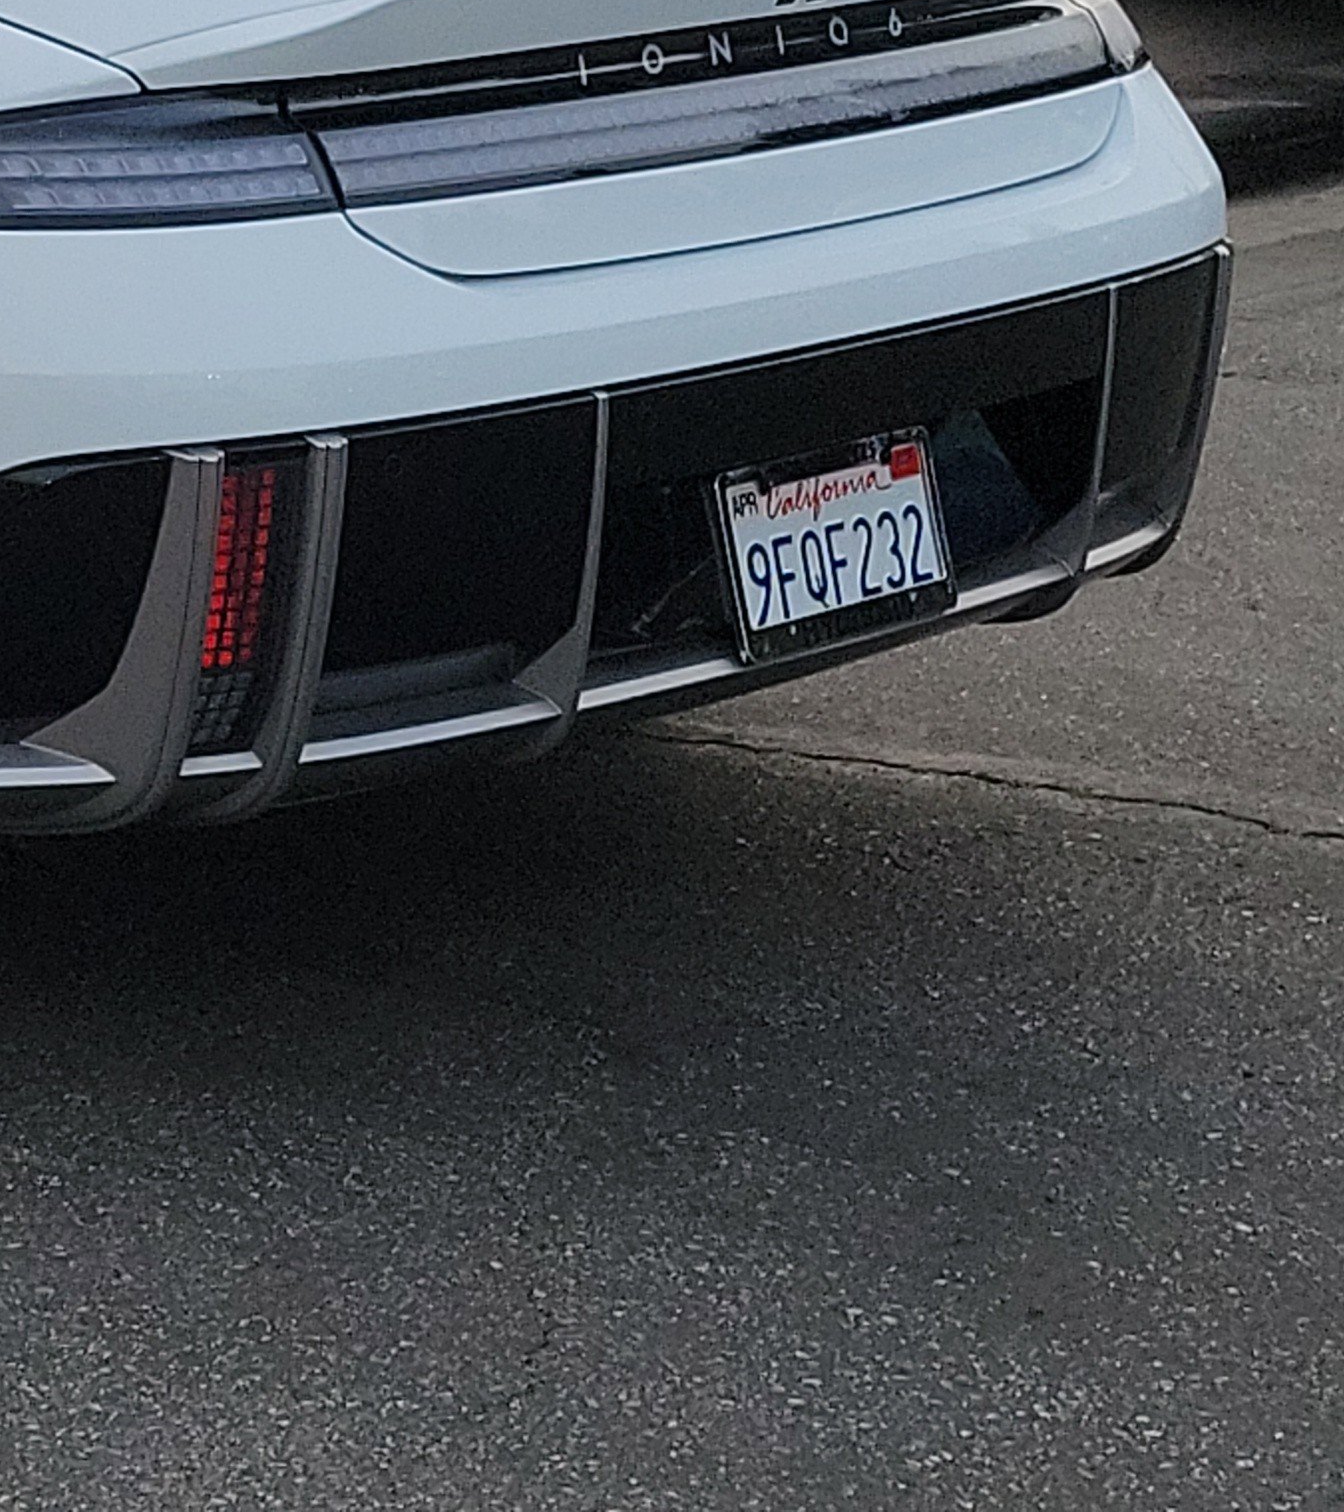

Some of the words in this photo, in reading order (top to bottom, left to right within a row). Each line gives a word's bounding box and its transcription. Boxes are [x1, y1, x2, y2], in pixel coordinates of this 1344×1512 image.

[578, 15, 849, 87] IONIQ
[888, 7, 903, 38] 6
[765, 471, 892, 521] California
[746, 504, 934, 627] 9FQF232
